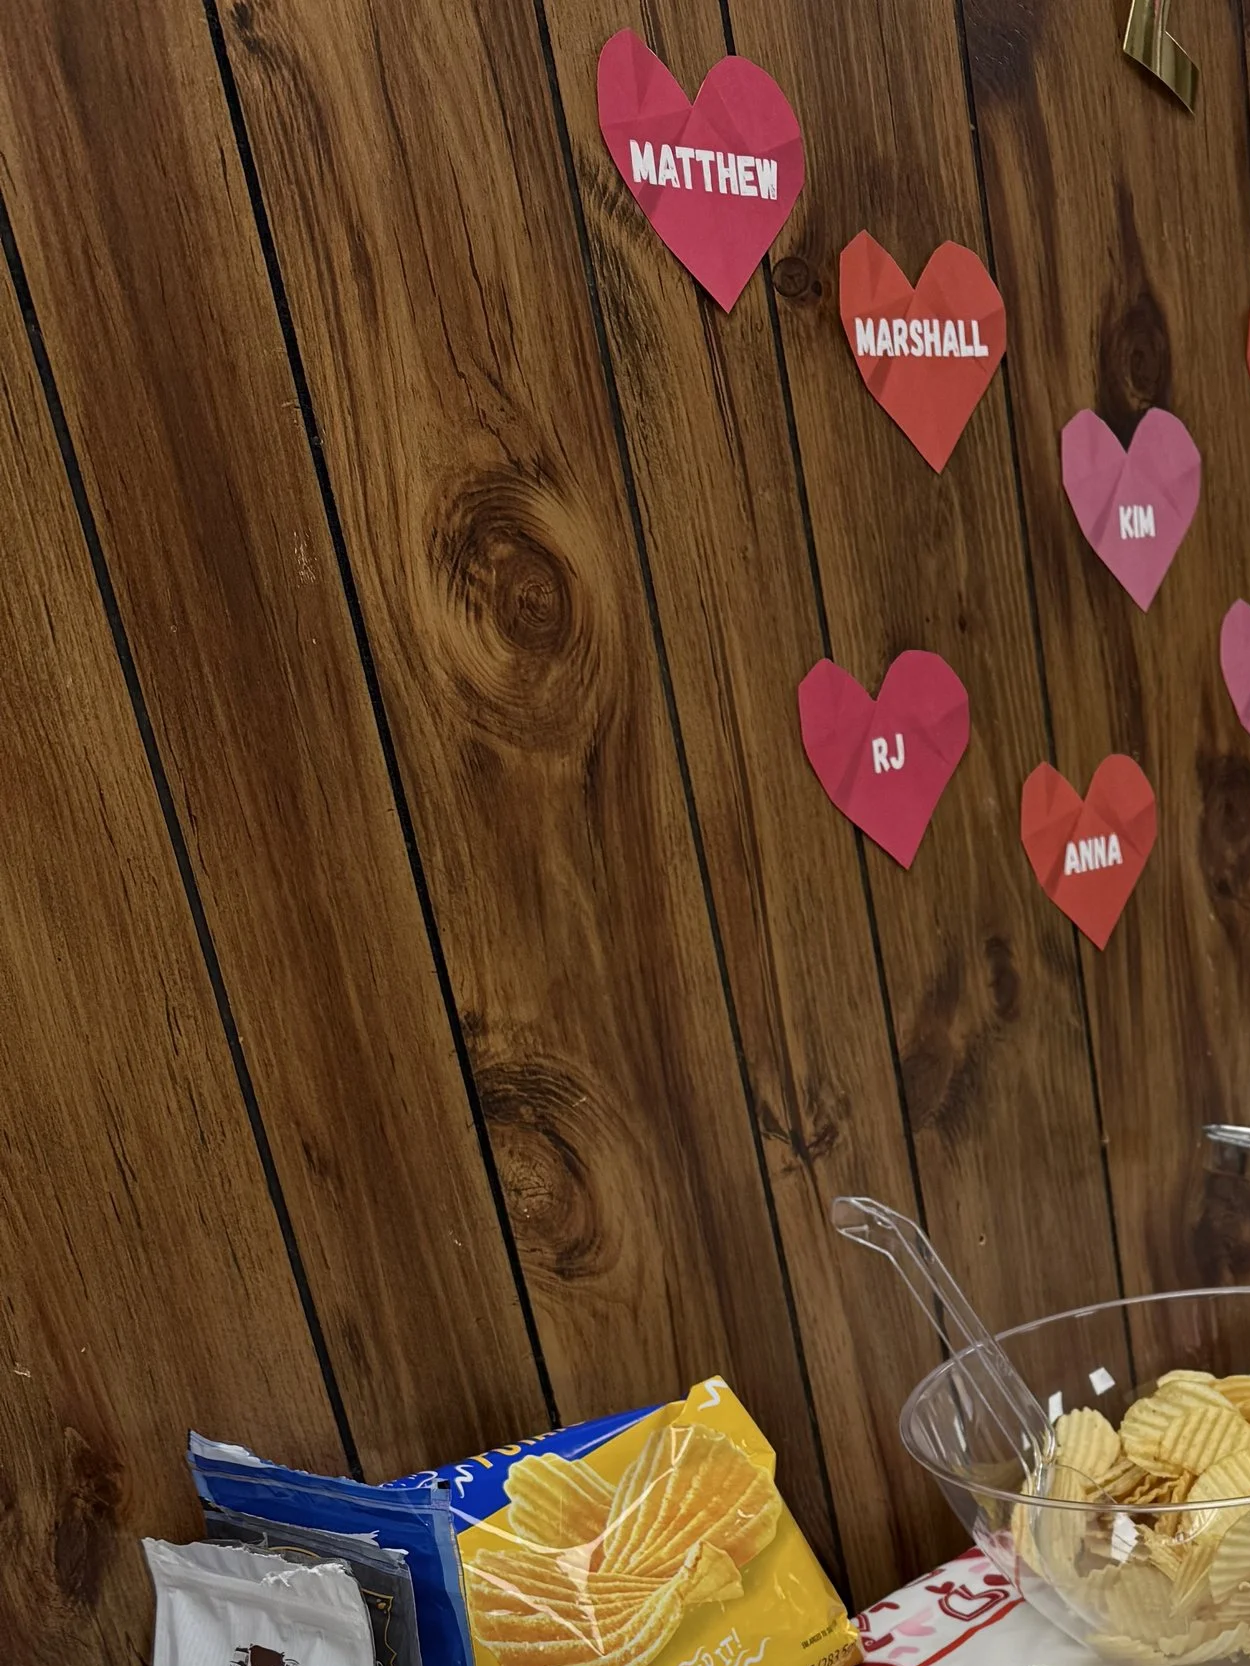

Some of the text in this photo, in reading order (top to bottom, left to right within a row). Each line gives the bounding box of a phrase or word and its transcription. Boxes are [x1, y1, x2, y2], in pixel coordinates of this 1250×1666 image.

[628, 138, 778, 200] MATTHEW
[855, 317, 989, 358] MARSHALL
[1118, 505, 1156, 540] KIM
[872, 733, 906, 774] RJ
[1063, 833, 1123, 876] ANNA
[714, 1627, 743, 1666] IT!
